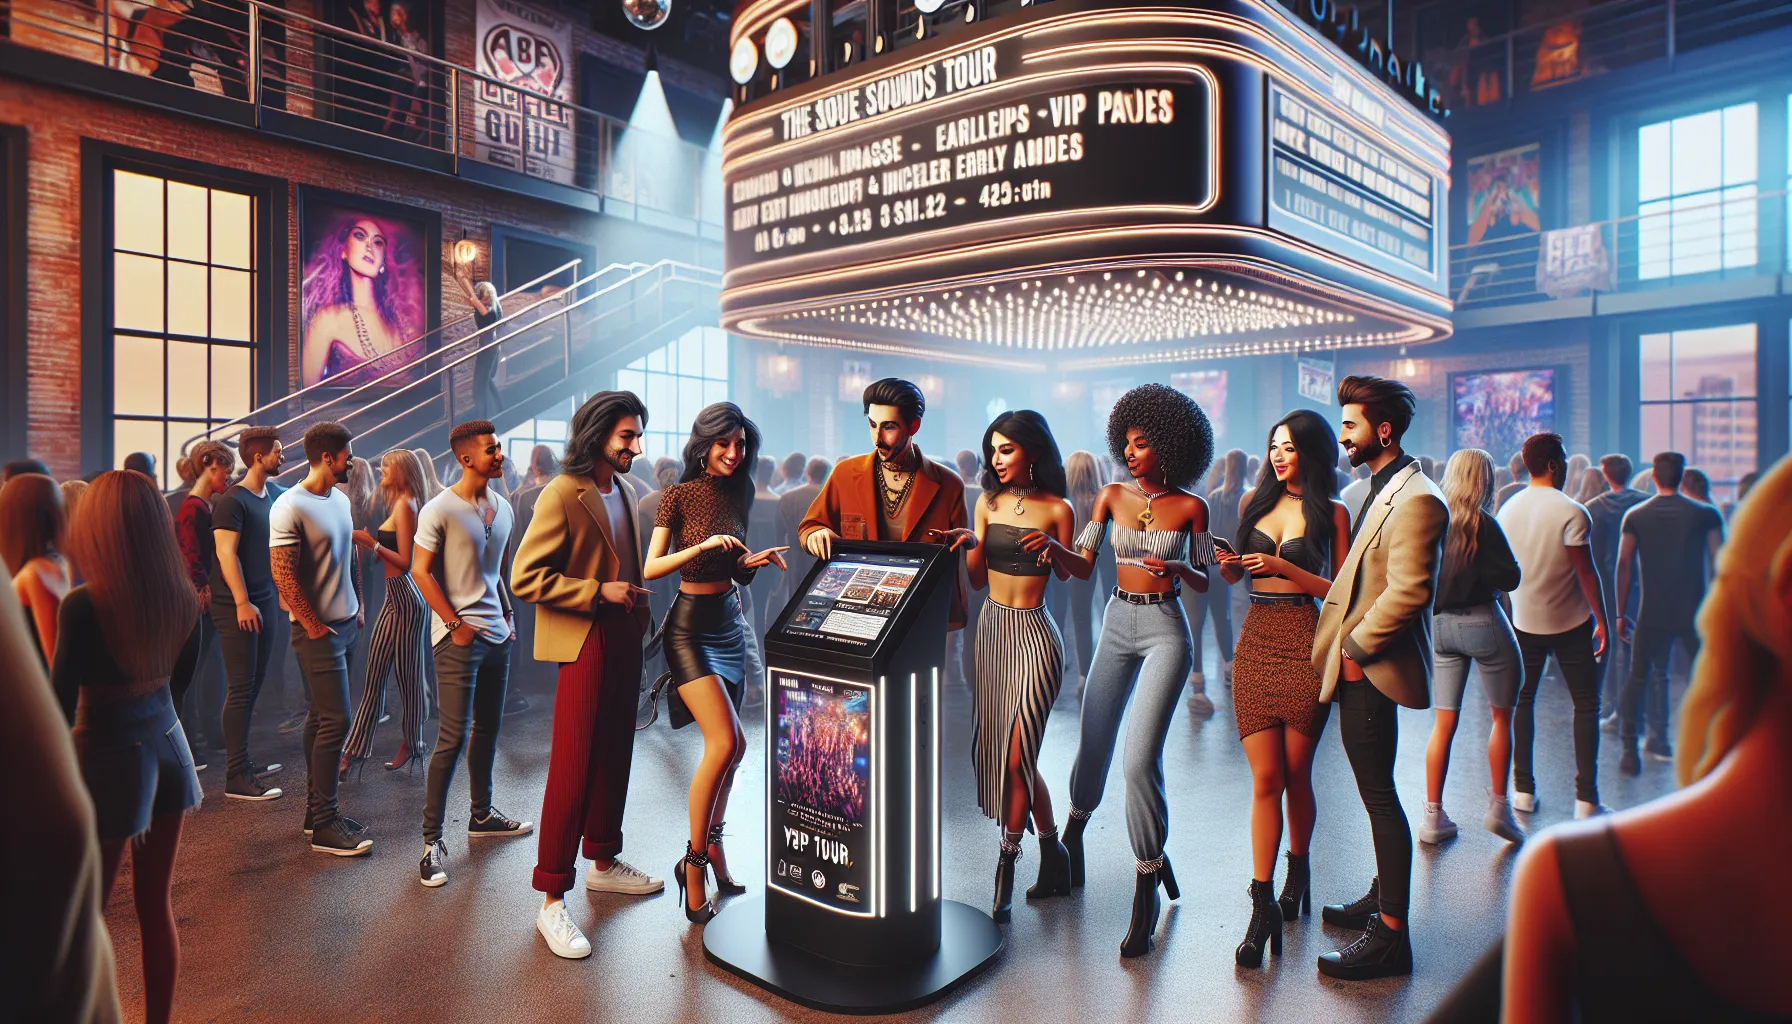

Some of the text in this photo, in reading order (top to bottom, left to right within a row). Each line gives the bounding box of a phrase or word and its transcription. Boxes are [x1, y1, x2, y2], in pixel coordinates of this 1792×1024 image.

[781, 106, 812, 141] THE
[865, 64, 937, 116] SOUNDS
[942, 46, 997, 93] TOUR
